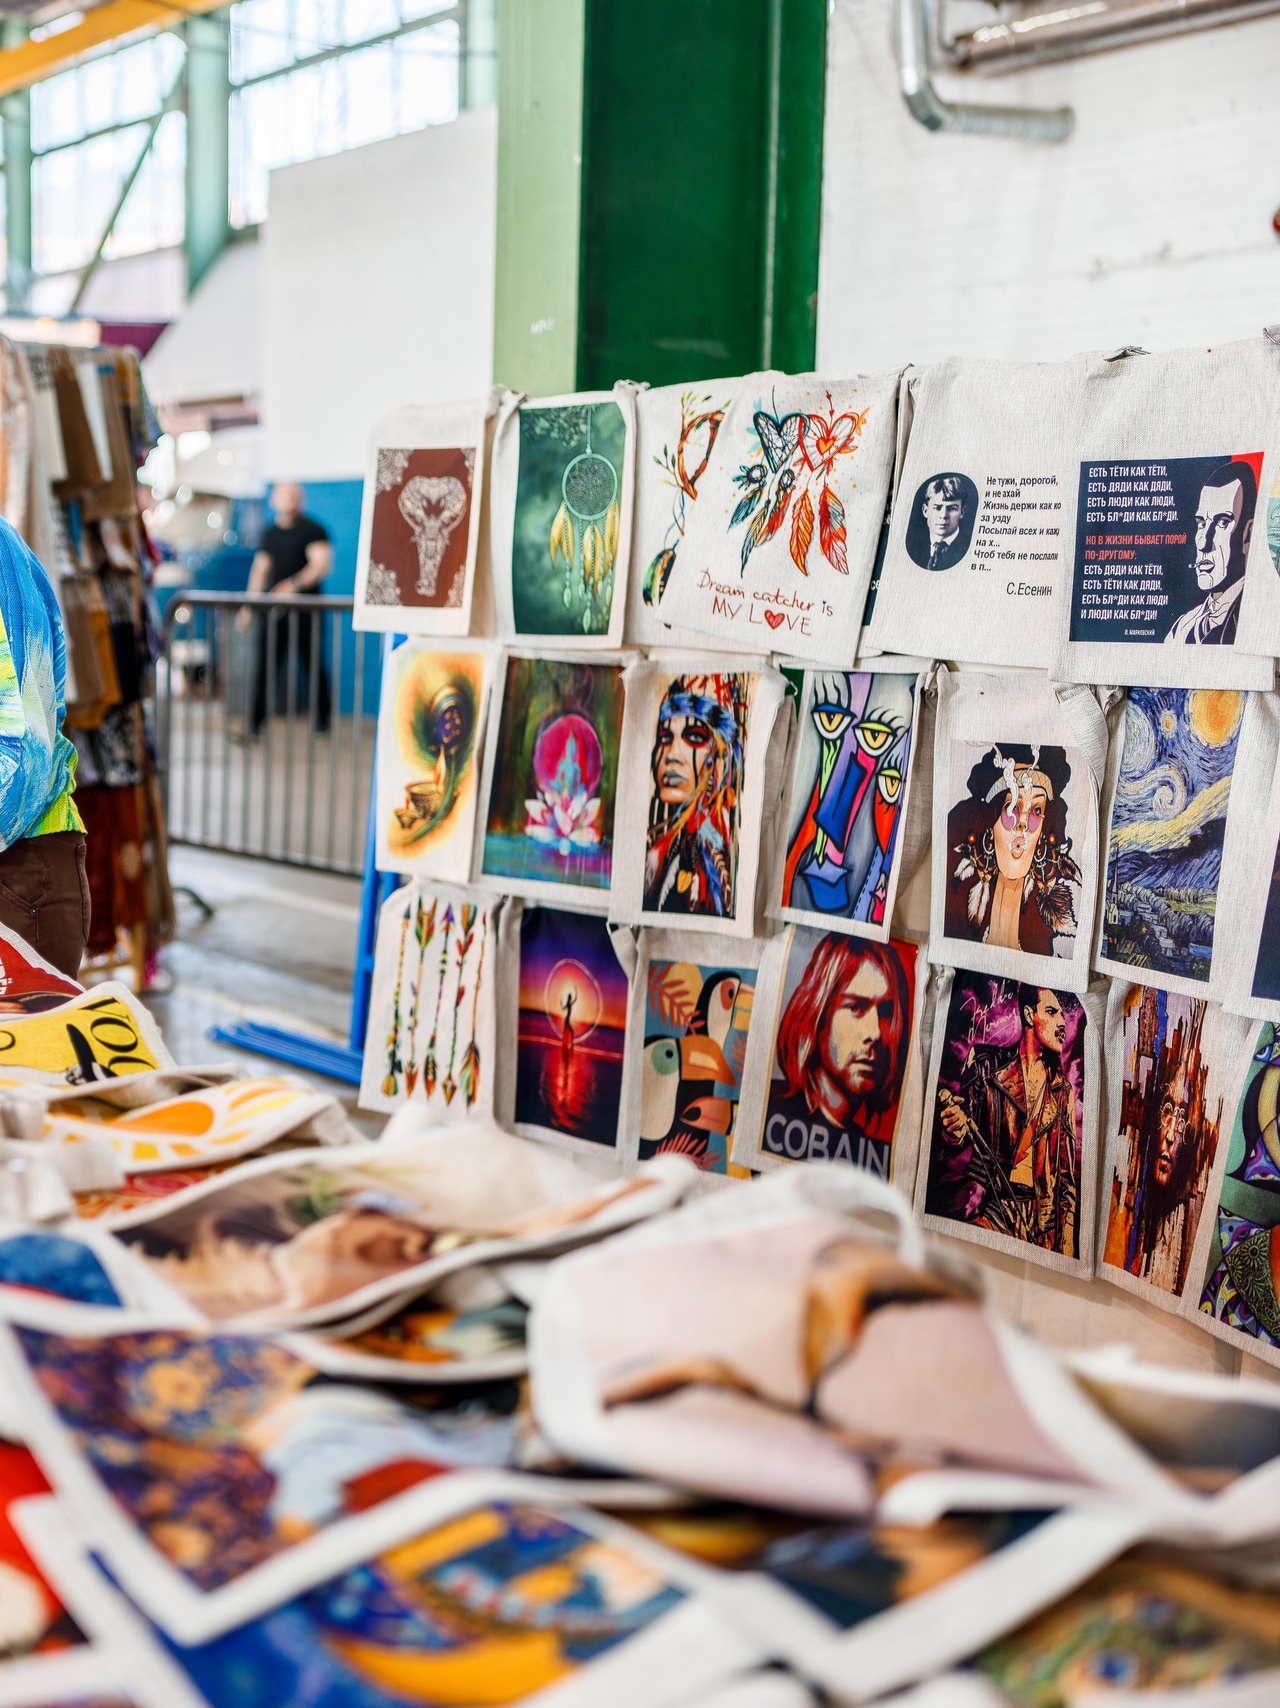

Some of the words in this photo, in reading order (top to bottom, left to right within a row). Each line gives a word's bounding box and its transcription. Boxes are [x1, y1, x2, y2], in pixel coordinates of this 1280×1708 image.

[1088, 468, 1108, 478] ЕСТЬ
[1109, 465, 1129, 477] ТЁТИ
[1130, 466, 1146, 476] КАК
[1148, 465, 1168, 476] ТЁТИ,
[986, 476, 996, 485] Не
[998, 478, 1017, 487] тужи,
[1020, 475, 1058, 487] дорогой,
[1088, 482, 1106, 492] ЕСТЬ
[1108, 482, 1132, 493] ДЯДИ
[1133, 481, 1149, 492] КАК
[1150, 481, 1172, 492] ДЯДИ,
[985, 490, 990, 498] и
[992, 490, 1001, 498] не
[1003, 489, 1020, 498] ахай
[983, 501, 1008, 510] Жизнь
[1010, 502, 1037, 512] держи
[1039, 502, 1052, 510] как
[1087, 497, 1106, 507] ЕСТЬ
[1108, 496, 1133, 508] ЛЮДИ
[1135, 496, 1150, 506] КАК
[1151, 496, 1175, 507] ЛЮДИ,
[992, 515, 1011, 524] узду
[1086, 512, 1105, 522] ЕСТЬ
[1136, 511, 1151, 522] КАК
[978, 526, 1017, 535] Посылай
[976, 539, 986, 547] на
[988, 539, 1000, 547] х...
[1085, 536, 1096, 545] НО
[1098, 536, 1104, 545] В
[1105, 535, 1133, 545] ЖИЗНИ
[1134, 535, 1164, 544] БЫВАЕТ
[1165, 532, 1187, 544] ПОРОЙ
[974, 550, 995, 559] Чтоб
[997, 550, 1016, 560] тебя
[1018, 552, 1028, 560] не
[1085, 550, 1137, 561] ПО-ДРУГОМУ:
[1084, 565, 1102, 575] ЕСТЬ
[1104, 565, 1126, 576] ДЯДИ
[1128, 565, 1143, 575] КАК
[1144, 563, 1163, 576] ТЁТИ,
[1006, 582, 1052, 596] С.Есенин
[1083, 580, 1102, 590] ЕСТЬ
[1103, 578, 1122, 590] ТЁТИ
[1123, 580, 1138, 590] КАК
[1140, 580, 1162, 591] ДЯДИ,
[696, 567, 745, 598] Dream
[752, 588, 815, 612] catcher
[822, 600, 834, 617] is
[1082, 594, 1101, 604] ЕСТЬ
[1130, 595, 1145, 604] КАК
[1146, 595, 1169, 606] ЛЮДИ
[712, 596, 742, 620] MY
[1081, 610, 1086, 619] И
[1088, 609, 1112, 620] ЛЮДИ
[1113, 610, 1129, 620] КАК
[766, 1113, 890, 1182] COBAIN
